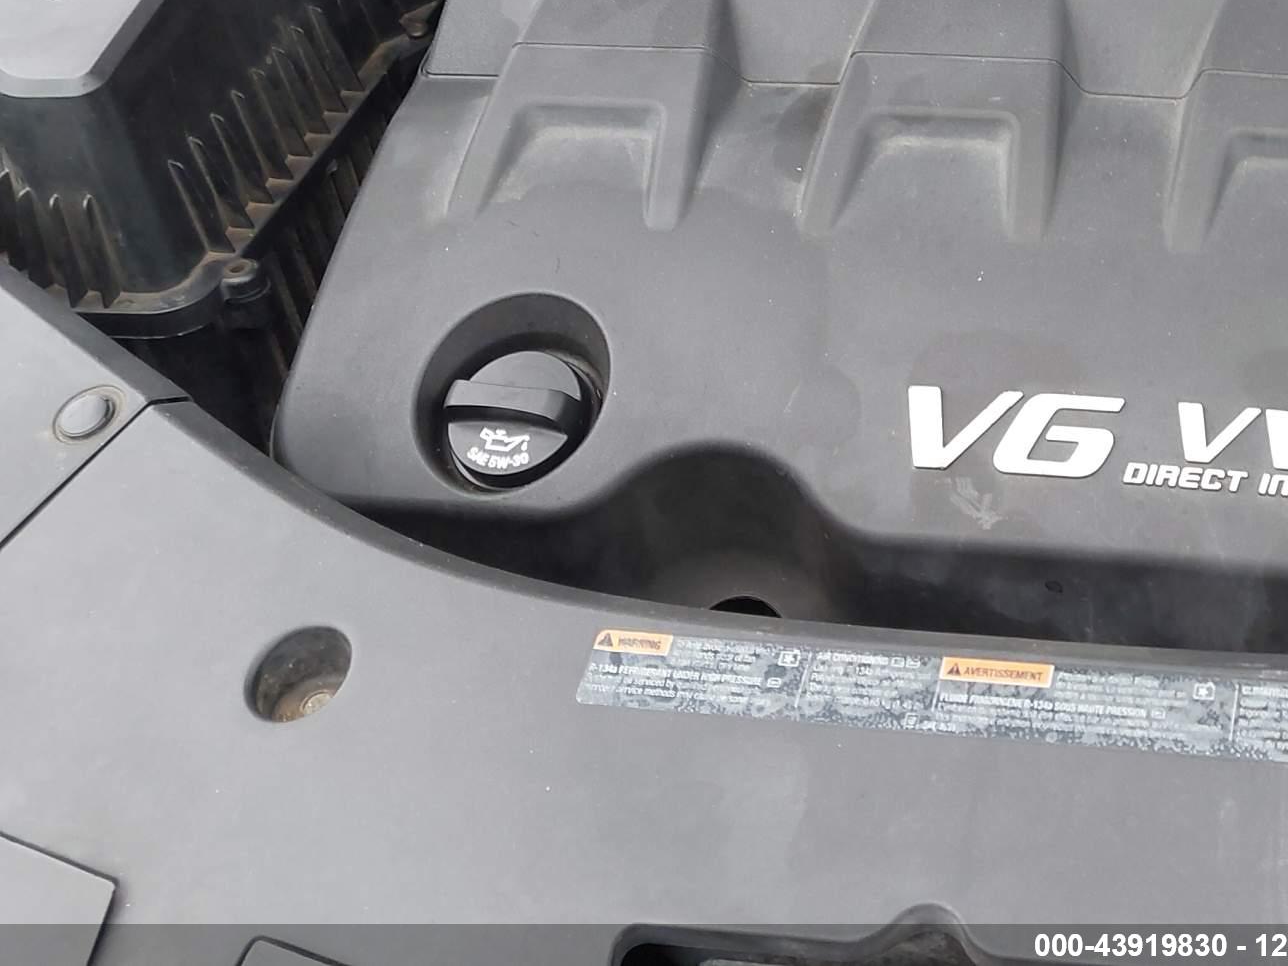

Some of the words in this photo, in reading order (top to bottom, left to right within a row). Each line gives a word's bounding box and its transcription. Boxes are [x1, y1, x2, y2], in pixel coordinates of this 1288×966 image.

[908, 385, 1125, 478] V6
[467, 447, 490, 466] SAE
[488, 452, 529, 469] 5W-30
[1123, 462, 1248, 493] DIRECT
[618, 637, 662, 650] WARNING
[963, 666, 1043, 681] AVERTISSEMENT
